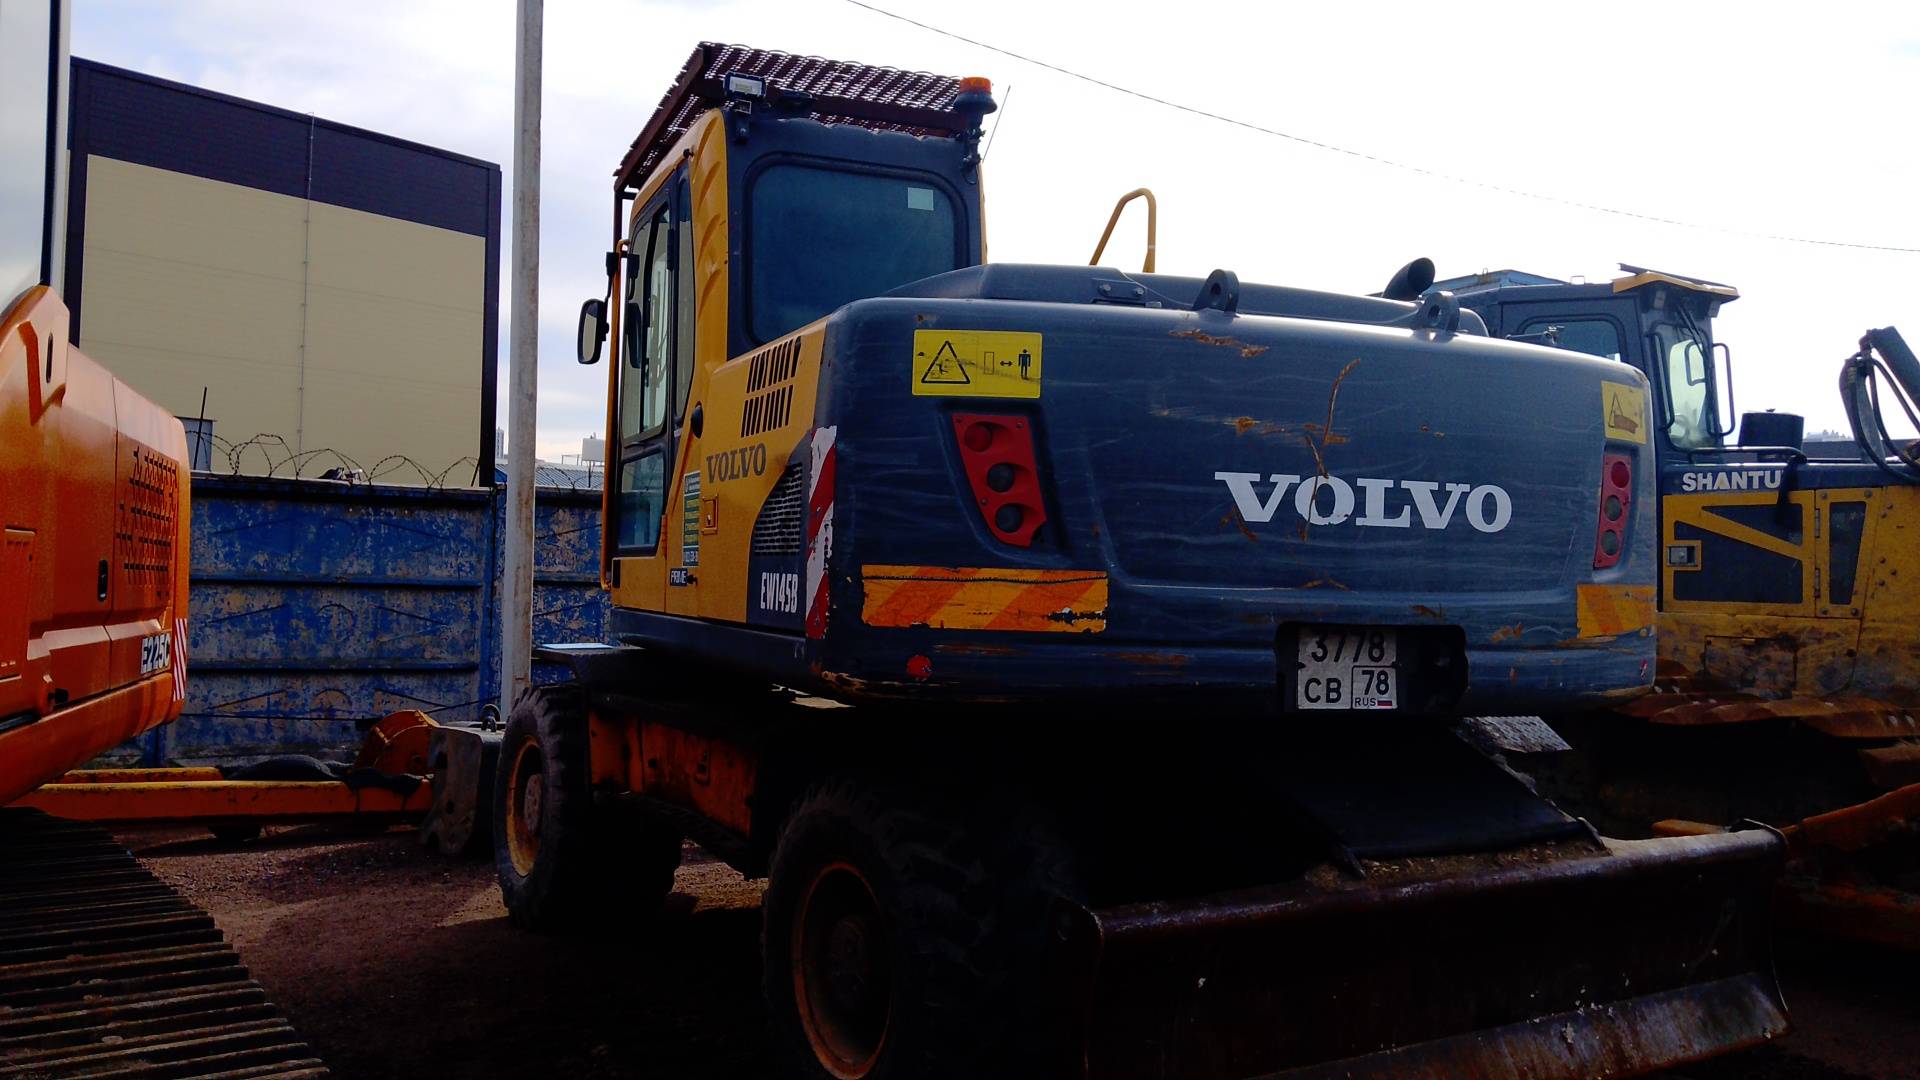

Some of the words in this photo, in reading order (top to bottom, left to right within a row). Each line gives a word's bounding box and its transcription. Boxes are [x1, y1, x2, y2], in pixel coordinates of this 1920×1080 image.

[705, 443, 767, 484] VOLVO
[1681, 470, 1783, 492] SHANTU
[1214, 471, 1514, 533] VOLVO
[759, 572, 800, 614] EW145B
[1311, 631, 1386, 663] 3778
[1304, 677, 1343, 704] CB
[1361, 670, 1391, 695] 78
[1354, 697, 1377, 707] RUS
